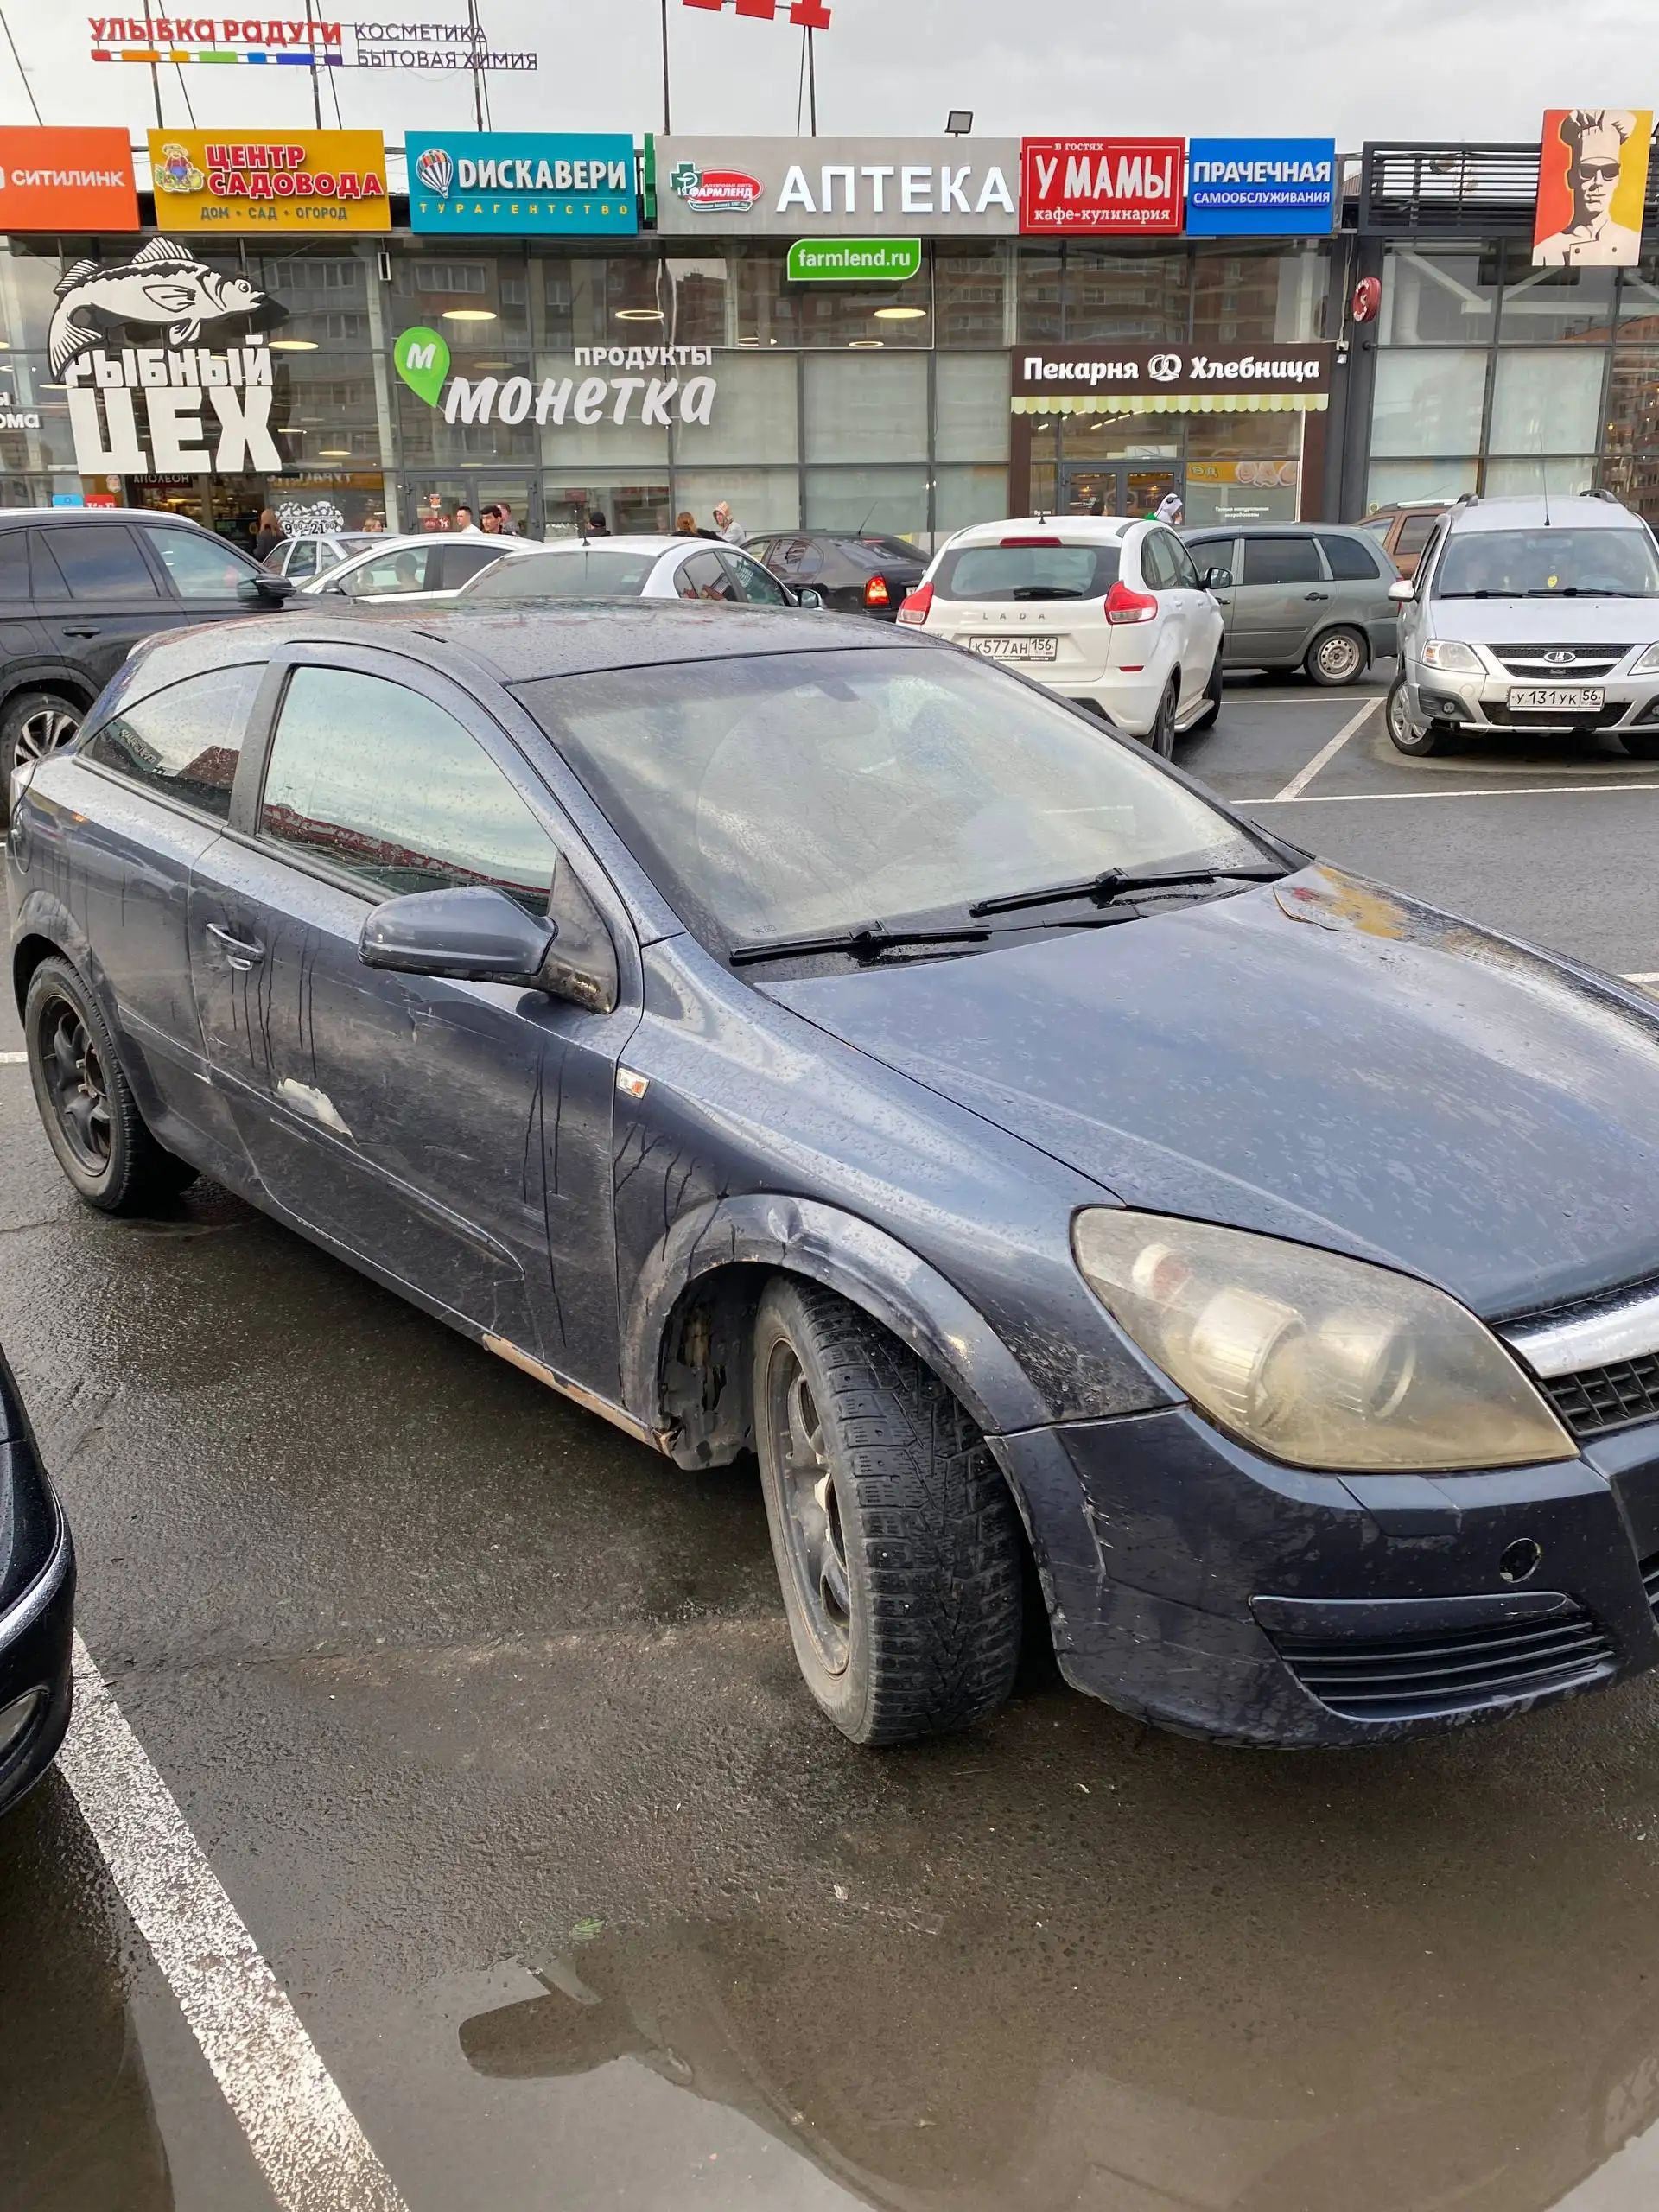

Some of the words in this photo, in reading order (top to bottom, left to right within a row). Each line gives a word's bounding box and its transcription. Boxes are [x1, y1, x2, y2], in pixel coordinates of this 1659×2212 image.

[354, 22, 487, 41] КОСМЕТИКА
[357, 49, 456, 67] БЫТОВАЯ
[463, 52, 537, 70] ХИМИЯ
[205, 144, 306, 172] ЦЕНТР
[11, 169, 125, 187] СИТИЛИНК
[1035, 155, 1058, 200] У
[1064, 156, 1173, 200] МАМЫ
[1192, 161, 1331, 184] ПРАЧЕЧНАЯ
[207, 172, 384, 199] САДОВОДА
[689, 186, 753, 199] ФАРМЛЕНД
[776, 164, 1015, 213] АПТЕКА
[419, 203, 628, 214] ТУРАГЕНТСТВО
[1193, 190, 1330, 206] САМООБСЛУЖИВАНИЯ
[201, 207, 228, 220] ДОМ
[248, 207, 277, 220] САД
[296, 207, 347, 220] ОГОРОД
[1034, 207, 1170, 225] кафе-кулинария
[798, 247, 912, 268] farmlend.ru
[64, 334, 273, 388] РЫБНЫЙ
[575, 346, 714, 368] ПРОДУКТЫ
[1024, 356, 1140, 385] Пекарня
[1189, 356, 1320, 383] Хлебница
[67, 386, 282, 475] ЦЕХ
[982, 612, 1046, 620] LADA
[1516, 690, 1577, 705] У131УК
